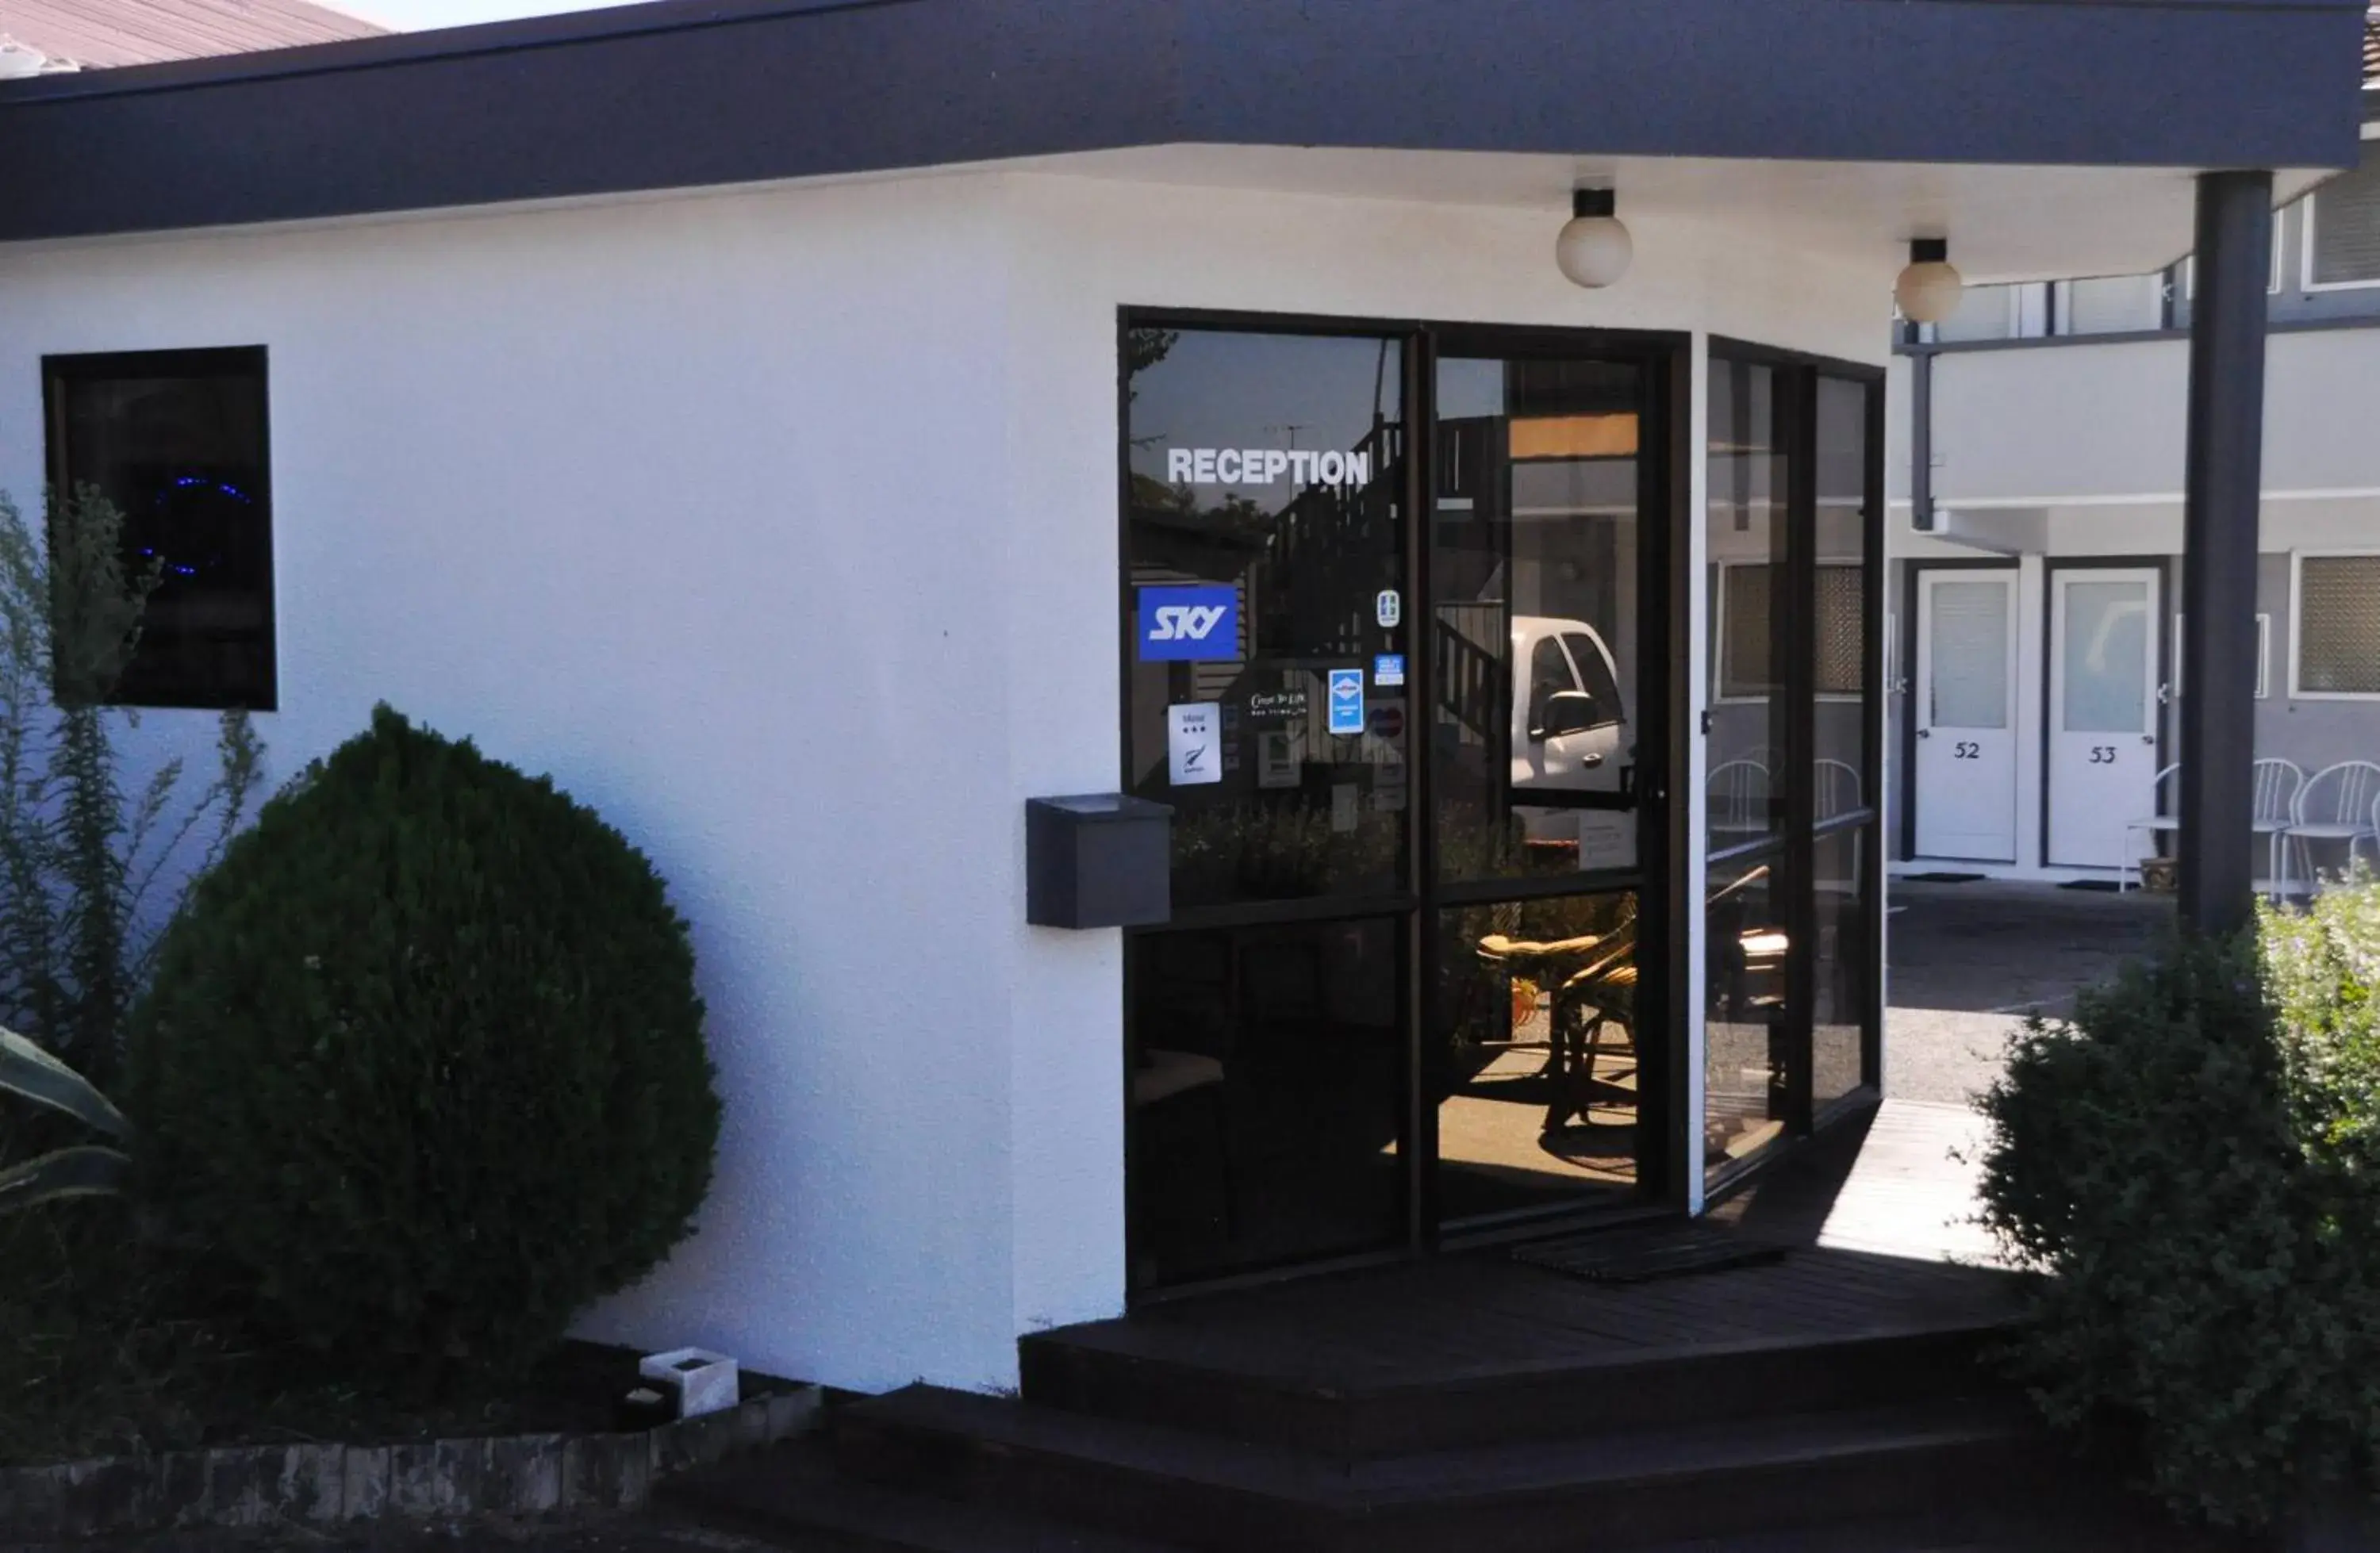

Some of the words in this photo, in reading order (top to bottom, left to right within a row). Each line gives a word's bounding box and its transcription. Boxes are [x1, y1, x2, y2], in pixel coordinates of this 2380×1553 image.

[1168, 448, 1368, 485] RECEPTION
[1149, 606, 1227, 640] SKY
[1954, 742, 1980, 759] 52
[2089, 746, 2116, 763] 53
